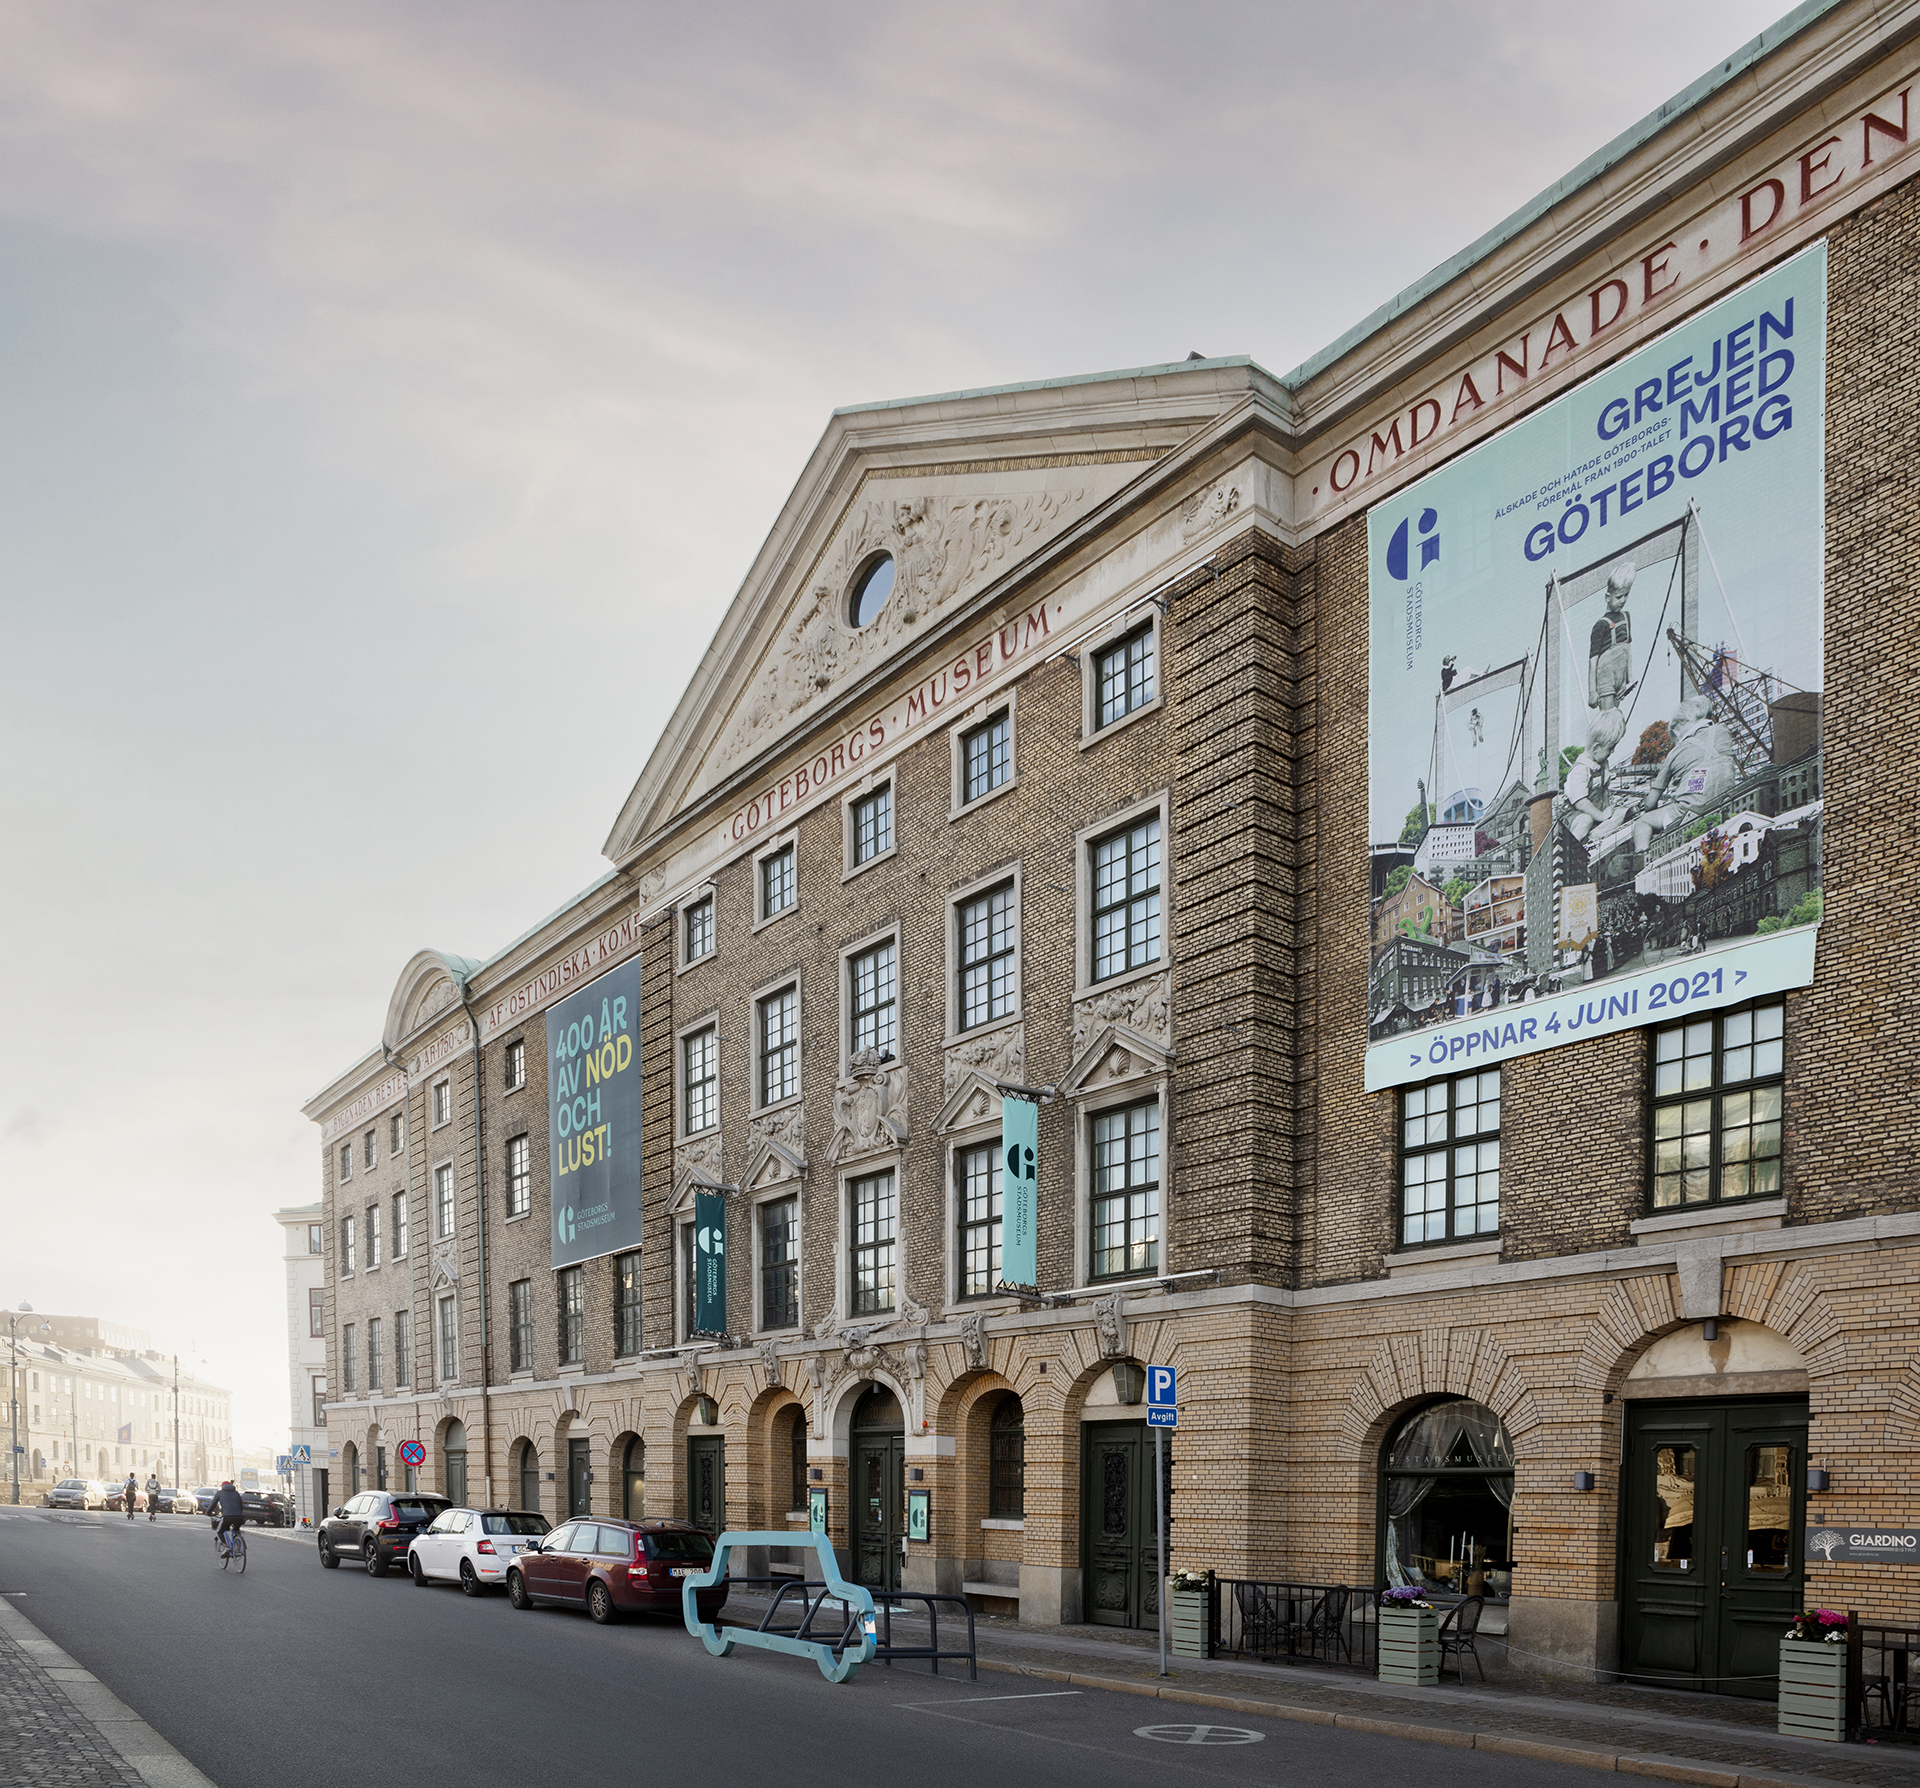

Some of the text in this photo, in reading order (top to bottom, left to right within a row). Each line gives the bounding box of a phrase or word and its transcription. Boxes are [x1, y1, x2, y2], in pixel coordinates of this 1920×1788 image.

[1329, 86, 1913, 494] OMDANADE DEN
[1597, 297, 1794, 441] GREJEN
[1679, 349, 1795, 441] MED
[1494, 417, 1672, 520] ÄLSKADE OCH HATADE GÖTEBORGS-
[1523, 393, 1793, 562] GÖTEBORG
[1536, 429, 1672, 511] FÖREMÅL FRÅN 1900-TALET
[1405, 586, 1414, 671] STADSMUSEUM
[1414, 581, 1423, 651] GÖTEBORGS
[731, 602, 1051, 841] GÖTEBORGS MUSEUM
[488, 1003, 504, 1030] AF
[509, 947, 592, 1015] OSTINDISKA
[1428, 967, 1725, 1065] ÖPPNAR 4 JUNI 2021
[437, 1031, 455, 1058] 1750
[555, 995, 628, 1062] 400 ÅR
[556, 1032, 633, 1103] AV NÖD
[332, 1095, 373, 1133] BYGGNADEN
[557, 1087, 601, 1138] OCH
[558, 1122, 612, 1177] LUST!
[576, 1202, 609, 1220] GÖTEBORGS
[577, 1211, 616, 1232] STADSMUSEUM
[1021, 1186, 1029, 1236] GÖTEBORGS
[1151, 1411, 1175, 1423] Avgift
[1155, 1369, 1172, 1402] P
[1405, 1453, 1514, 1463] STADSMUSEET
[1849, 1533, 1917, 1548] GIARDINO
